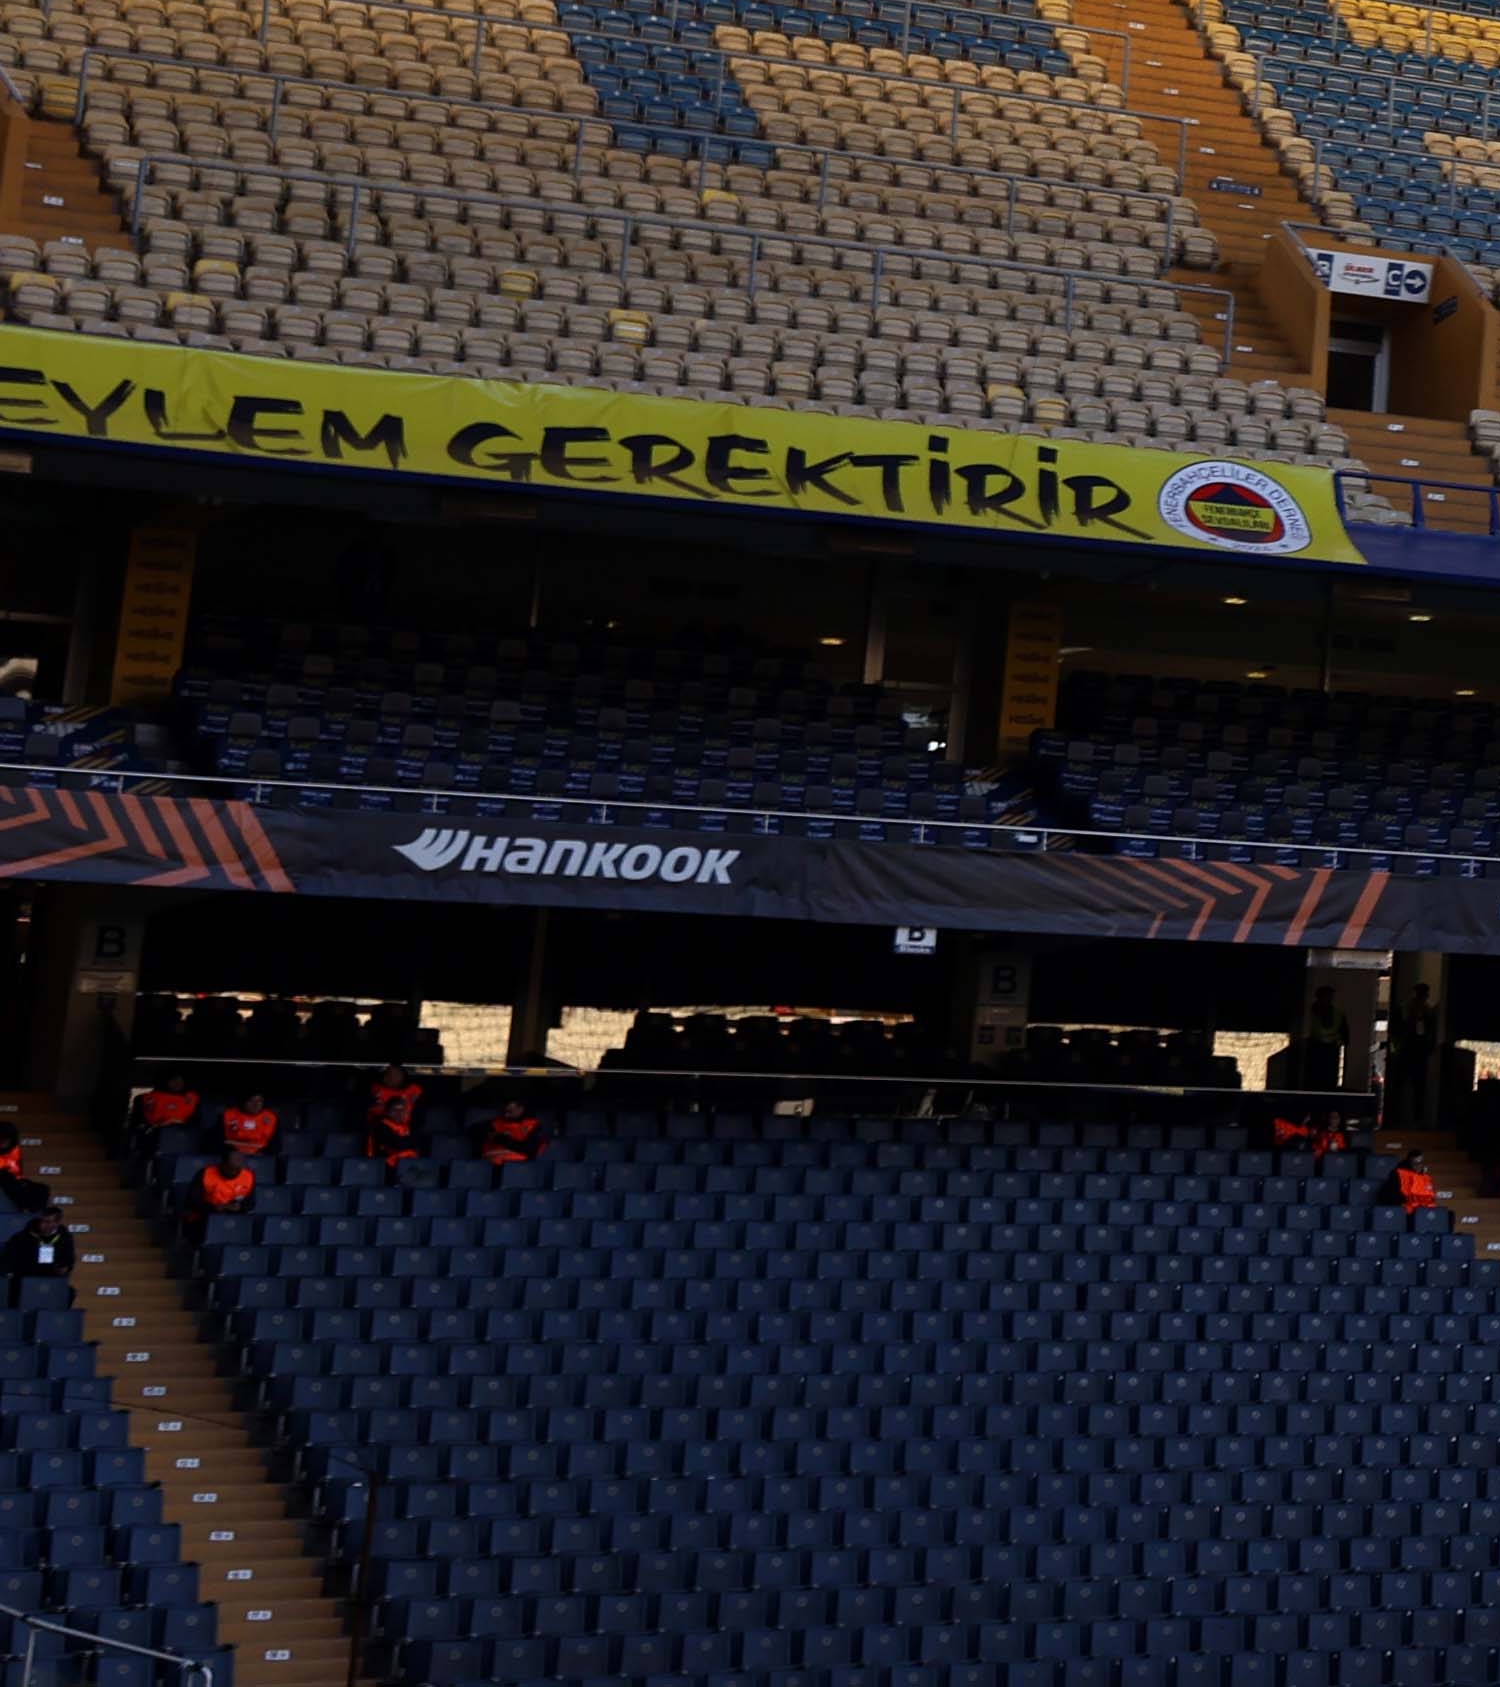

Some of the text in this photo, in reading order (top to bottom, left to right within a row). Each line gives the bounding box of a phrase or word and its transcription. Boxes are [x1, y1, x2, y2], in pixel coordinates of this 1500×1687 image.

[446, 422, 1155, 541] GEREKTİRİR
[97, 925, 126, 958] B
[994, 965, 1017, 994] B
